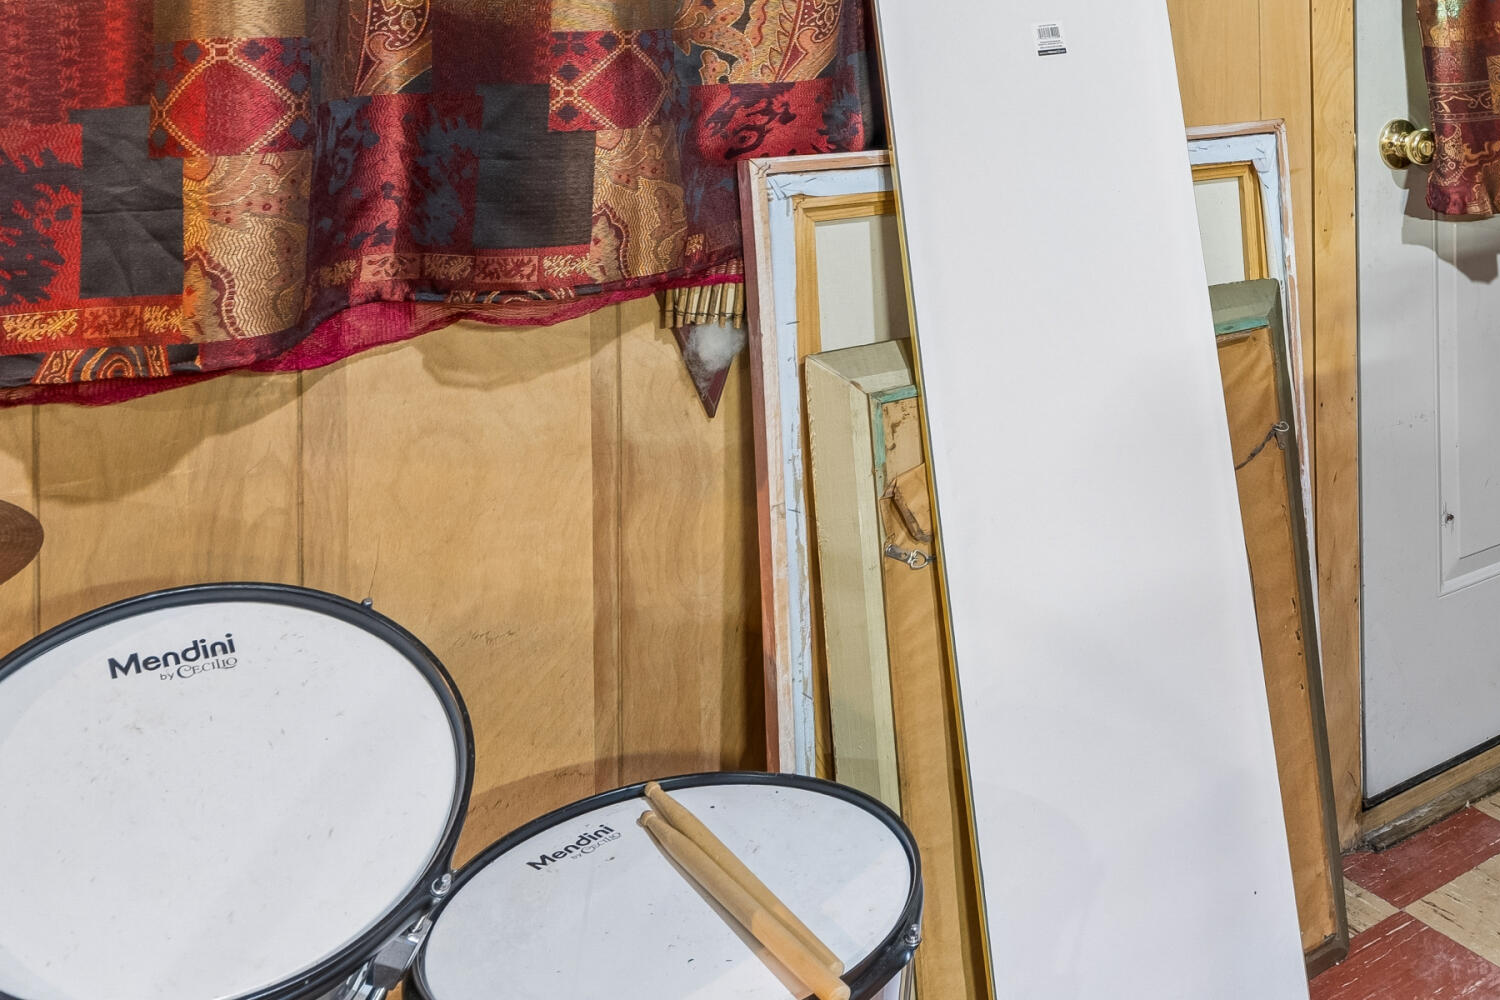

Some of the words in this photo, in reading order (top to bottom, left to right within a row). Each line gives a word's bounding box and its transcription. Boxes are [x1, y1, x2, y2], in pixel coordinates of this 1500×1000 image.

[107, 632, 237, 680] Mendini
[159, 672, 175, 681] by
[525, 824, 615, 871] Mendini
